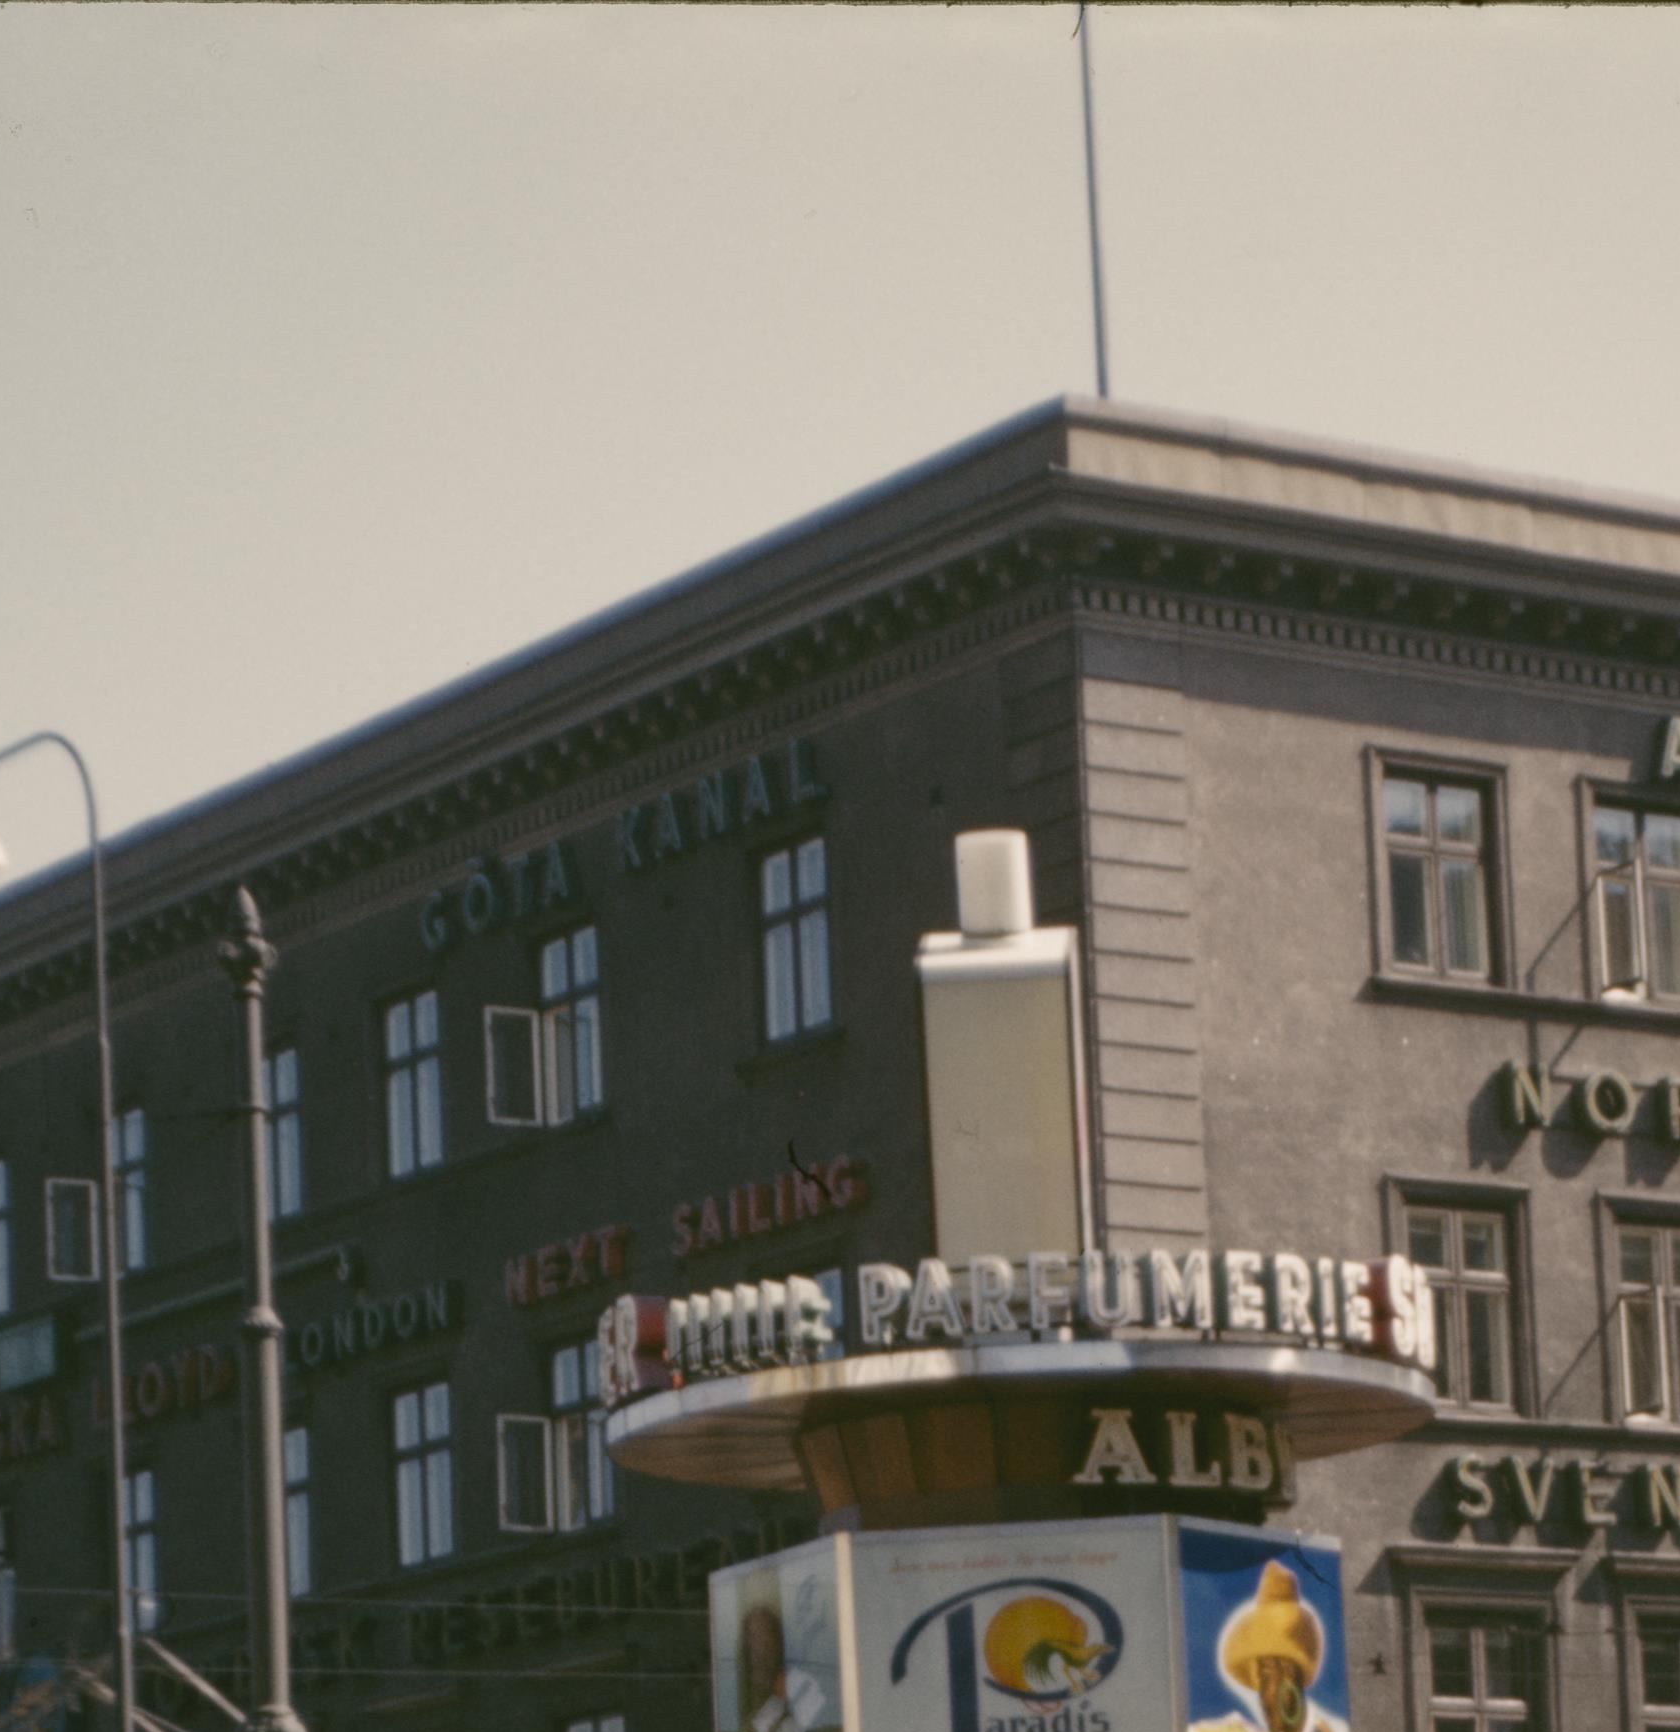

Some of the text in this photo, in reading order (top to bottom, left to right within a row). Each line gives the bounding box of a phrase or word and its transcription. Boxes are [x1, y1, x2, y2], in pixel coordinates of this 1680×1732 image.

[422, 738, 827, 951] GÖTA KANAL
[503, 1152, 861, 1306] NEXT SAILING
[284, 1277, 449, 1374] ONDON
[858, 1248, 1372, 1347] PARFUMERIE
